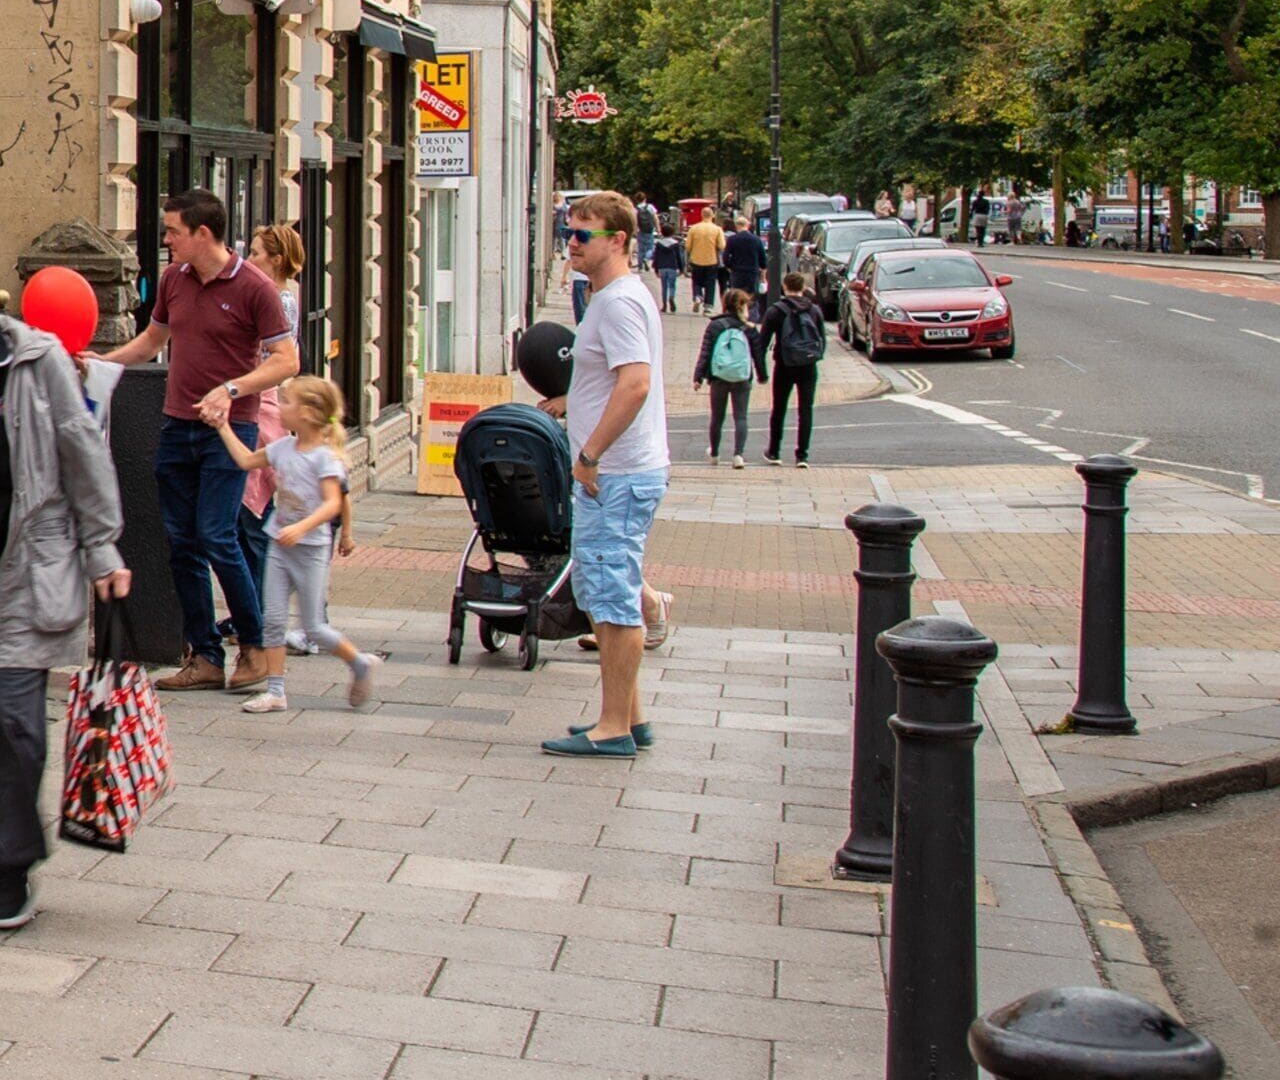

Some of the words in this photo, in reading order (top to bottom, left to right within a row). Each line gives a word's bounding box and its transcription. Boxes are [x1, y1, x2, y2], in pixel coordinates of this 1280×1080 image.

[423, 63, 466, 86] LET
[420, 89, 460, 121] GREED
[418, 137, 464, 145] URSTON
[420, 145, 453, 154] COOK
[441, 158, 464, 166] 9977
